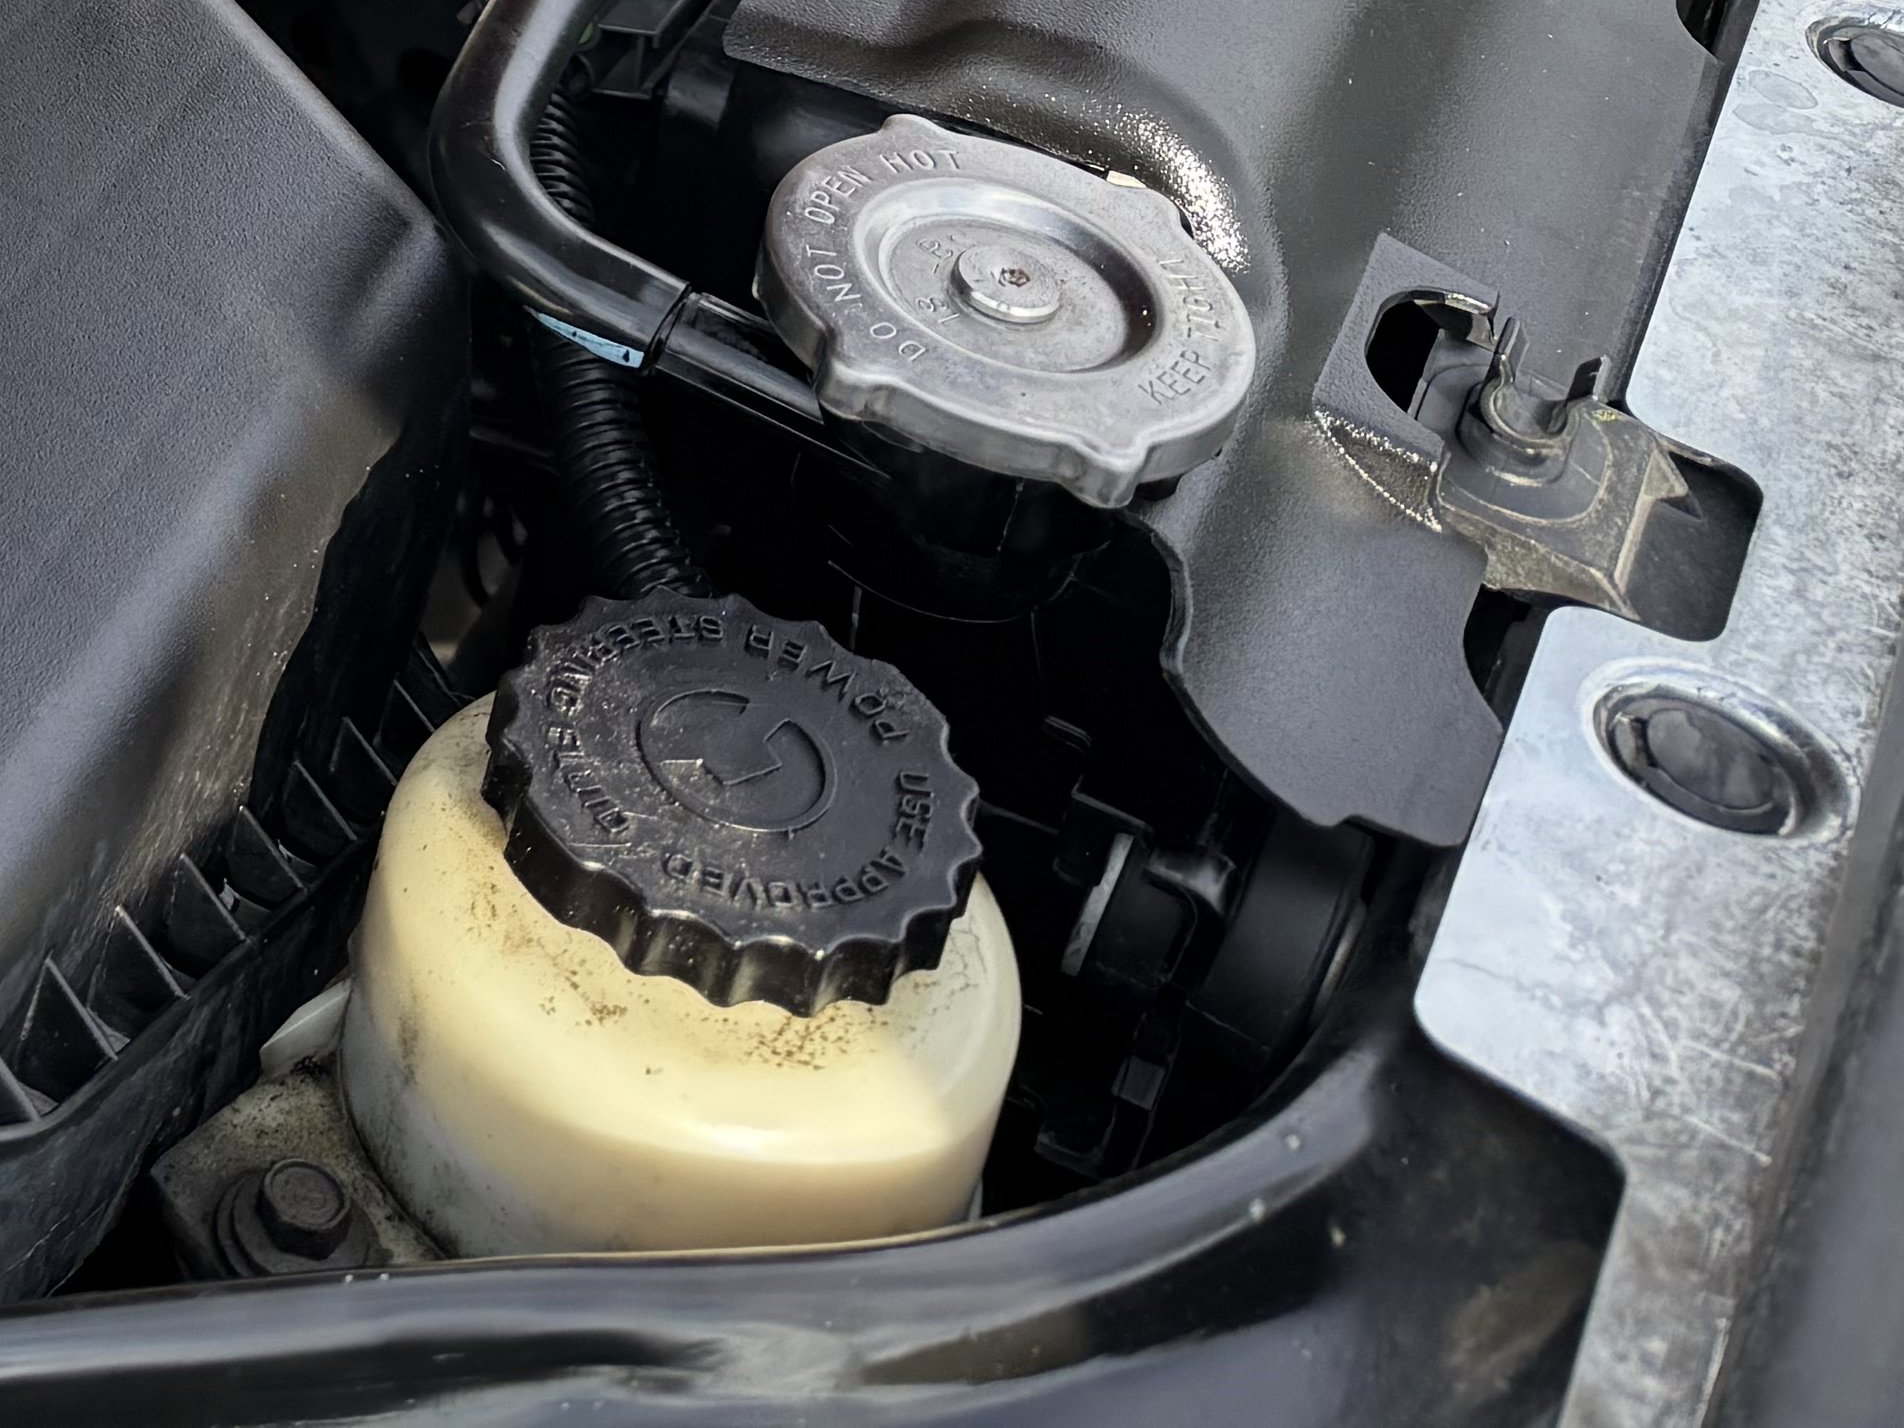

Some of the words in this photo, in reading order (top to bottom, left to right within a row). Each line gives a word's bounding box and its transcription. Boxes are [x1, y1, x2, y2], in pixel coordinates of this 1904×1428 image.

[879, 149, 960, 176] HOT
[804, 164, 871, 227] OPEN
[803, 244, 862, 304] NOT
[1157, 257, 1223, 343] TIGHT
[871, 321, 927, 362] DO
[1138, 348, 1215, 406] KEEP
[545, 614, 725, 716] STEERING
[744, 622, 911, 744] POWER
[894, 770, 935, 843] USE
[662, 847, 911, 909] APPROVED
